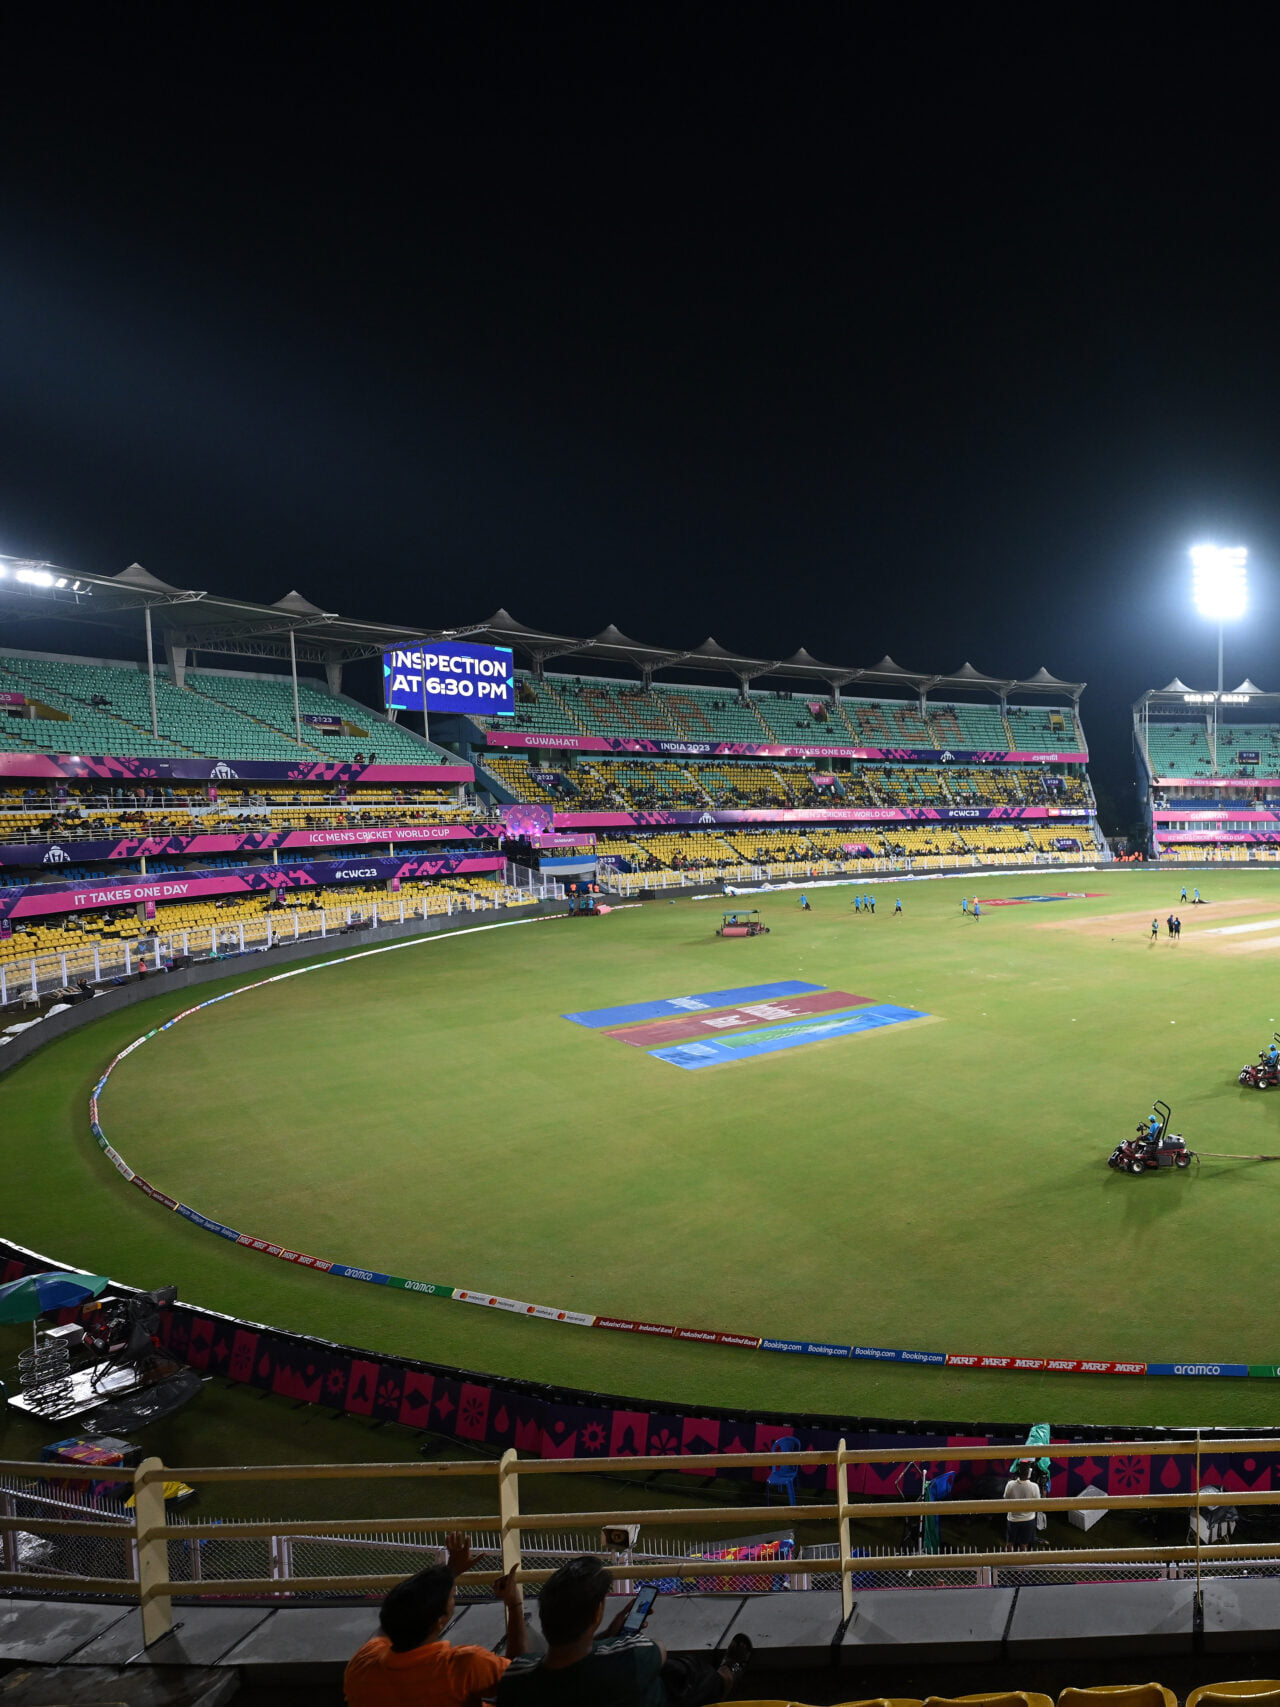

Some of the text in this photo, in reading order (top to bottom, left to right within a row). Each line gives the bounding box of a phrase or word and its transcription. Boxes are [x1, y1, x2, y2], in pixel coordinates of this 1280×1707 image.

[392, 650, 507, 677] INSPECTION
[392, 674, 508, 699] AT 6:30 PM
[525, 737, 579, 747] GUWAHATI
[660, 742, 710, 751] INDIA 2023
[793, 747, 820, 756] TAKES
[822, 748, 838, 756] ONE
[823, 811, 851, 819] CRICKET
[309, 828, 450, 842] ICC MEN'S CRICKET WORLD CUP
[335, 868, 377, 879] #CWC23
[74, 884, 189, 906] IT TAKES ONE DAY
[314, 1260, 331, 1270] MRF
[344, 1268, 373, 1281] aramco
[405, 1280, 436, 1293] aramco
[763, 1340, 802, 1351] Booking.com
[807, 1345, 848, 1356] Booking.com
[855, 1348, 896, 1358] Booking.com
[901, 1352, 943, 1362] Booking.com
[949, 1356, 1144, 1373] MRF MRF MRF MRF MRF MRF
[1174, 1365, 1221, 1375] aramco
